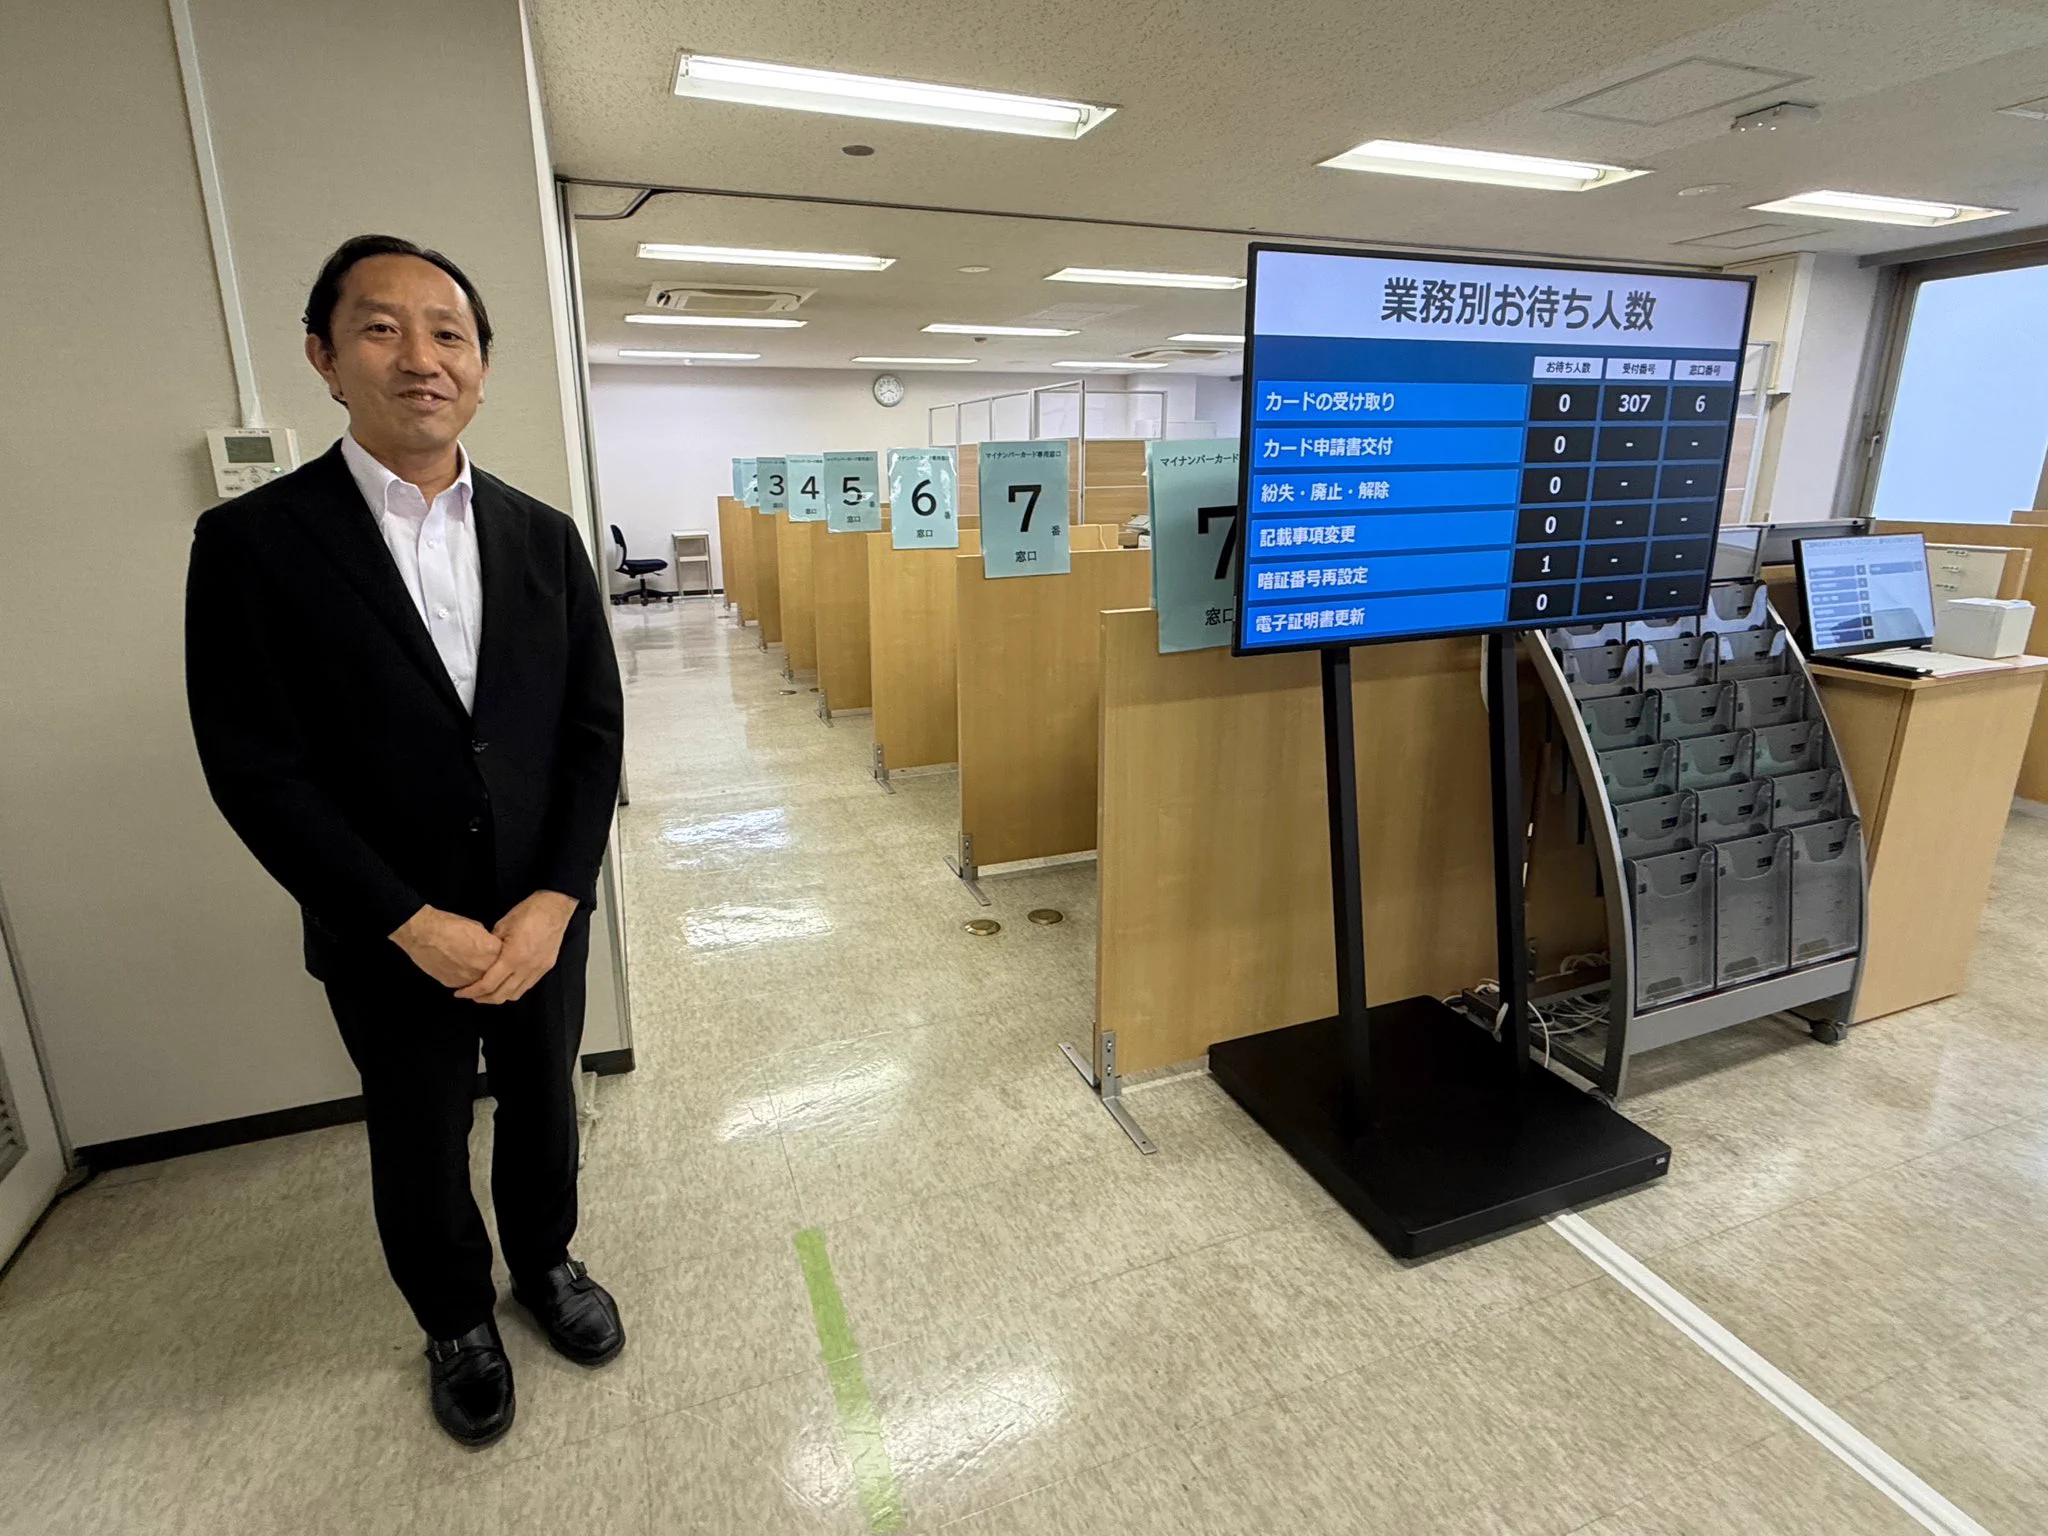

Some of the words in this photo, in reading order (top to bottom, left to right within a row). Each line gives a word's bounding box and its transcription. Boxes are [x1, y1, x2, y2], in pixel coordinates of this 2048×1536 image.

[1381, 276, 1657, 331] 業務別お待ち人数
[1546, 361, 1592, 374] お待ち人数
[1622, 363, 1657, 376] 受付番号
[1689, 365, 1721, 377] 窓口番号
[1265, 391, 1395, 412] カードの受け取り
[1558, 393, 1571, 413] 0
[1618, 394, 1651, 413] 307
[1695, 395, 1706, 413] 6
[1263, 436, 1393, 458] カード申請書交付
[1554, 435, 1566, 455] 0
[768, 474, 785, 496] 3
[800, 475, 820, 500] 4
[842, 476, 862, 506] 5
[911, 478, 937, 517] 6
[1261, 481, 1390, 503] 紛失・廃止・解除
[1549, 476, 1561, 495] 0
[1008, 484, 1042, 533] 7
[1051, 525, 1062, 536] 番
[916, 528, 934, 538] 窓口
[1197, 505, 1238, 580] 7
[1259, 525, 1356, 548] 記載事項変更
[1545, 515, 1557, 534] 0
[1015, 550, 1037, 563] 窓口
[1257, 566, 1368, 590] 暗証番号再設定
[1541, 555, 1551, 573] 1
[1255, 607, 1365, 633] 電子証明書更新
[1536, 593, 1548, 611] 0
